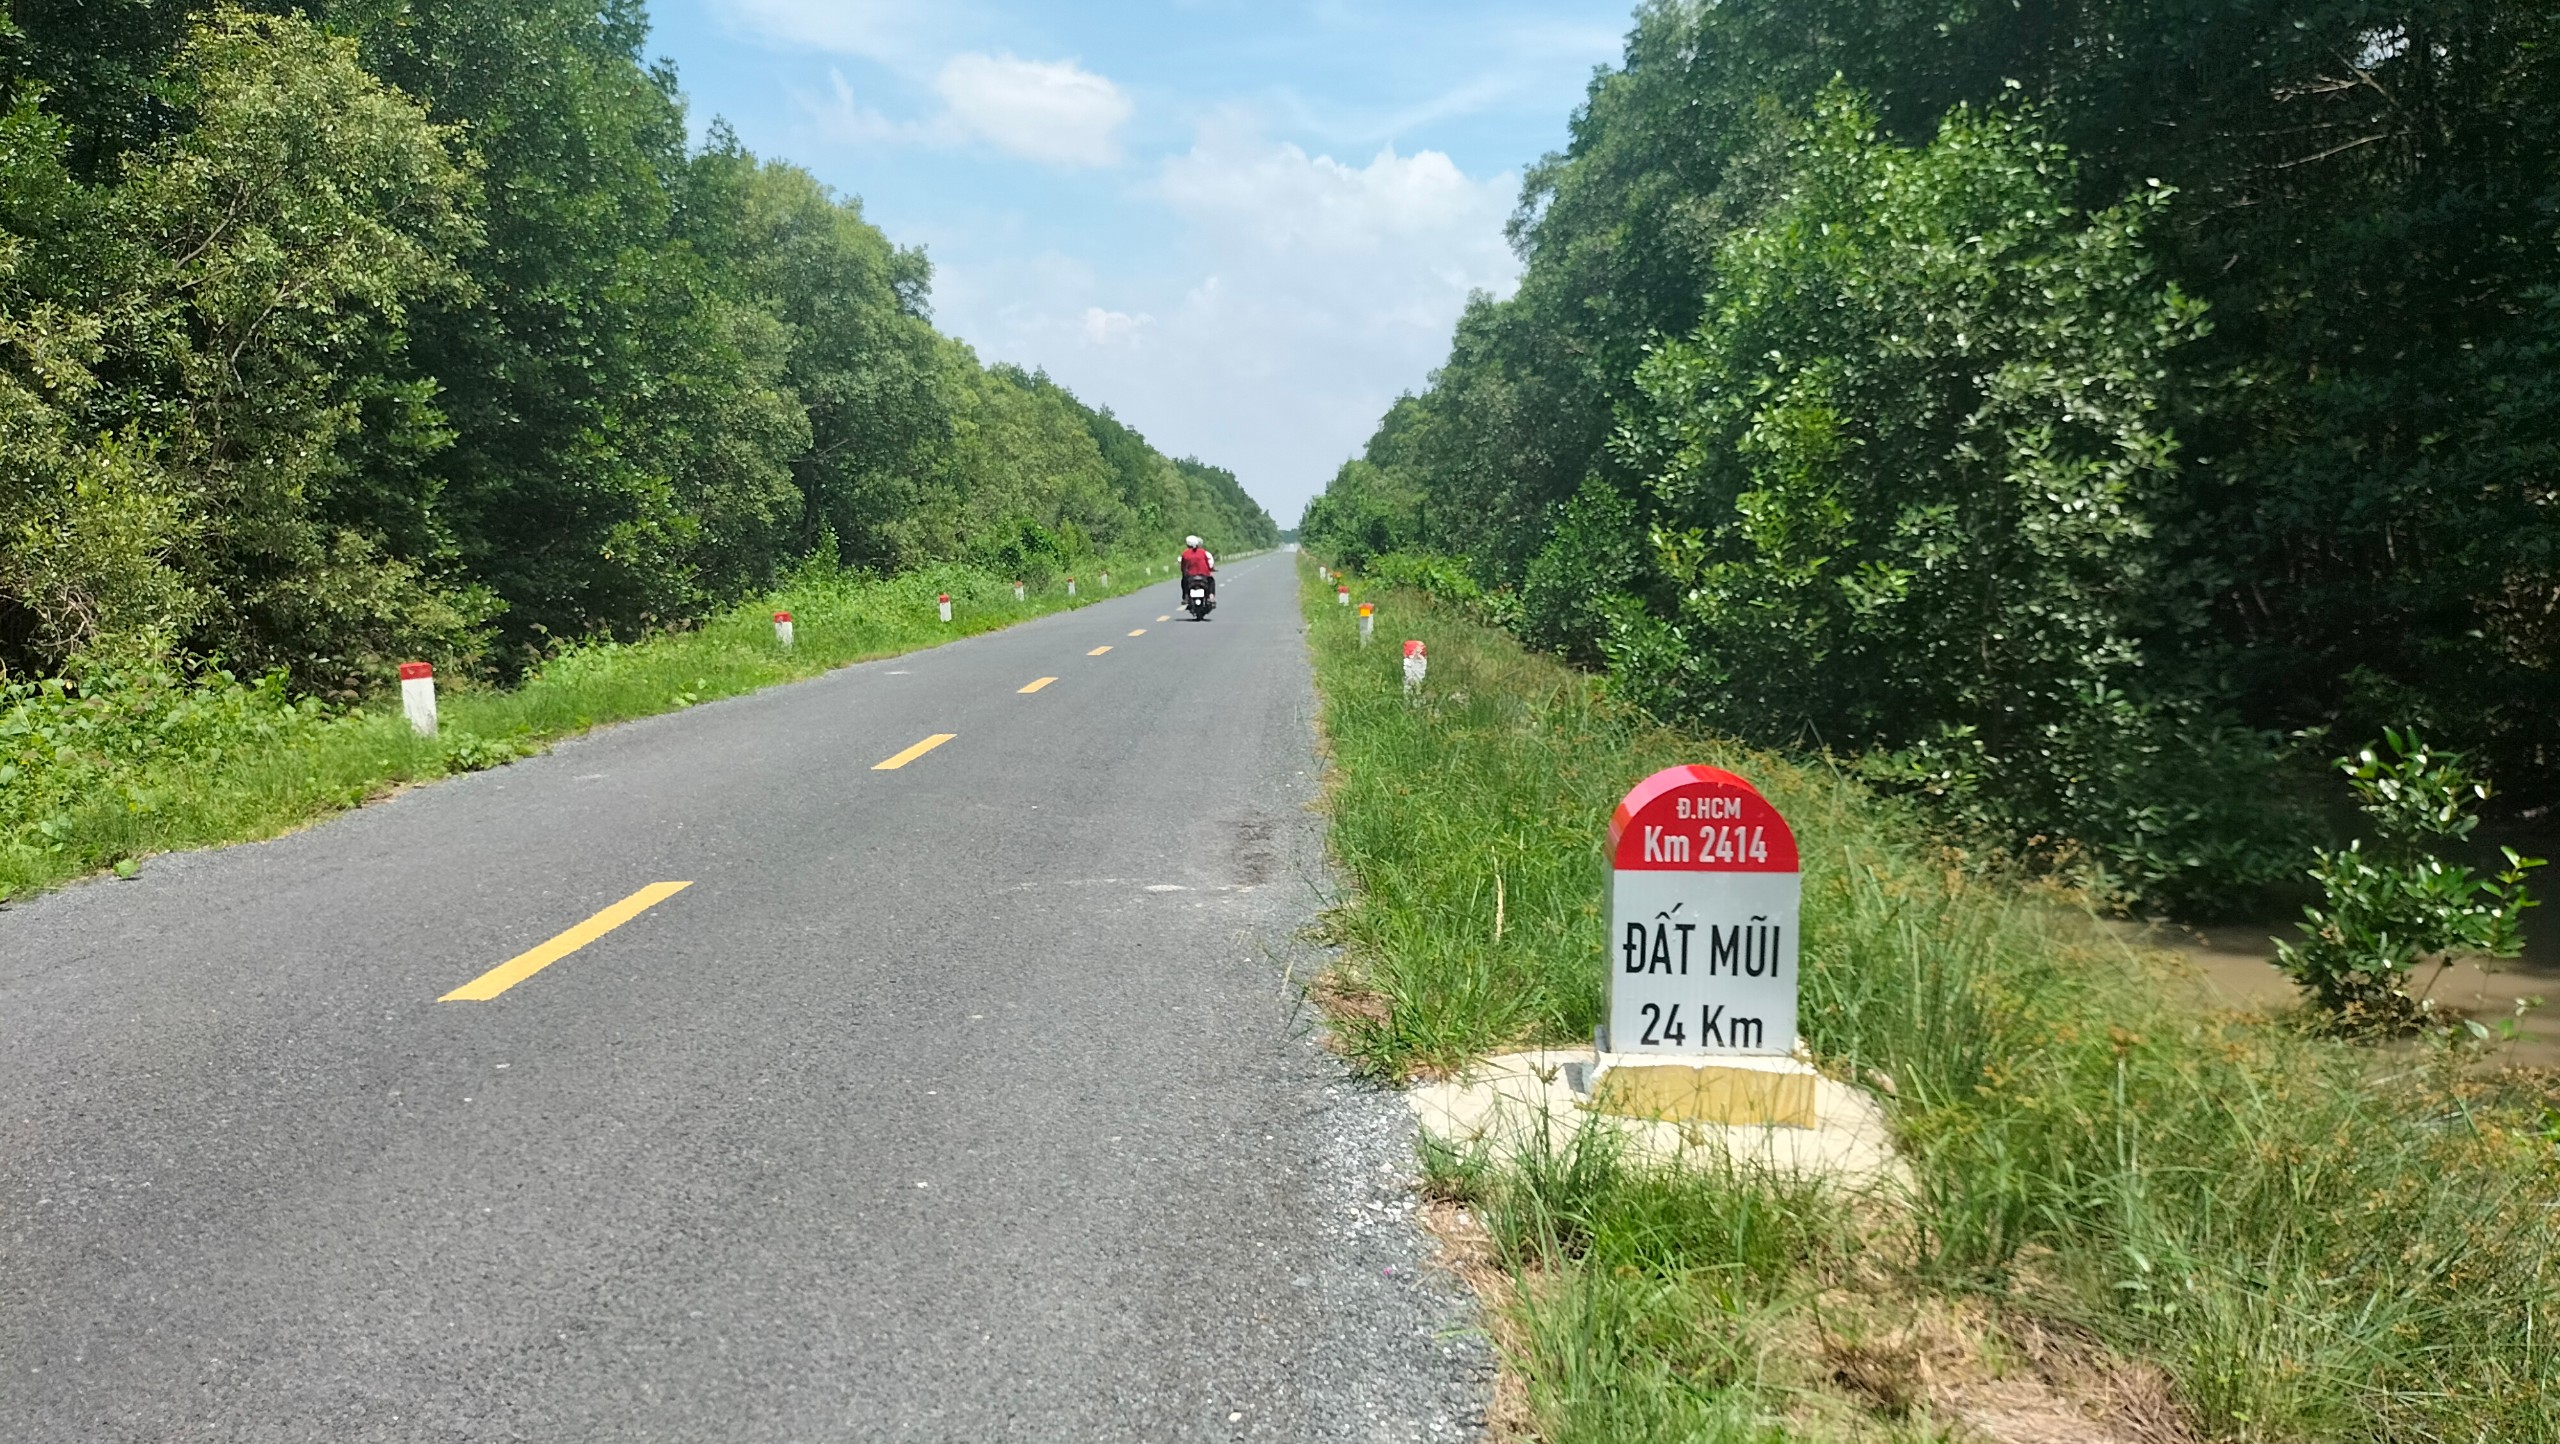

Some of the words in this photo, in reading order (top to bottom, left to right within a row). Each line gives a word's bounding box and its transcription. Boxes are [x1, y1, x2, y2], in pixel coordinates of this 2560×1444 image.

[1676, 797, 1741, 820] Đ.HCM
[1644, 826, 1689, 863] Km
[1699, 826, 1768, 863] 2414
[1623, 902, 1696, 975] ĐẤT
[1710, 915, 1780, 977] MŨI
[1640, 1003, 1686, 1046] 24
[1701, 1004, 1763, 1048] Km
